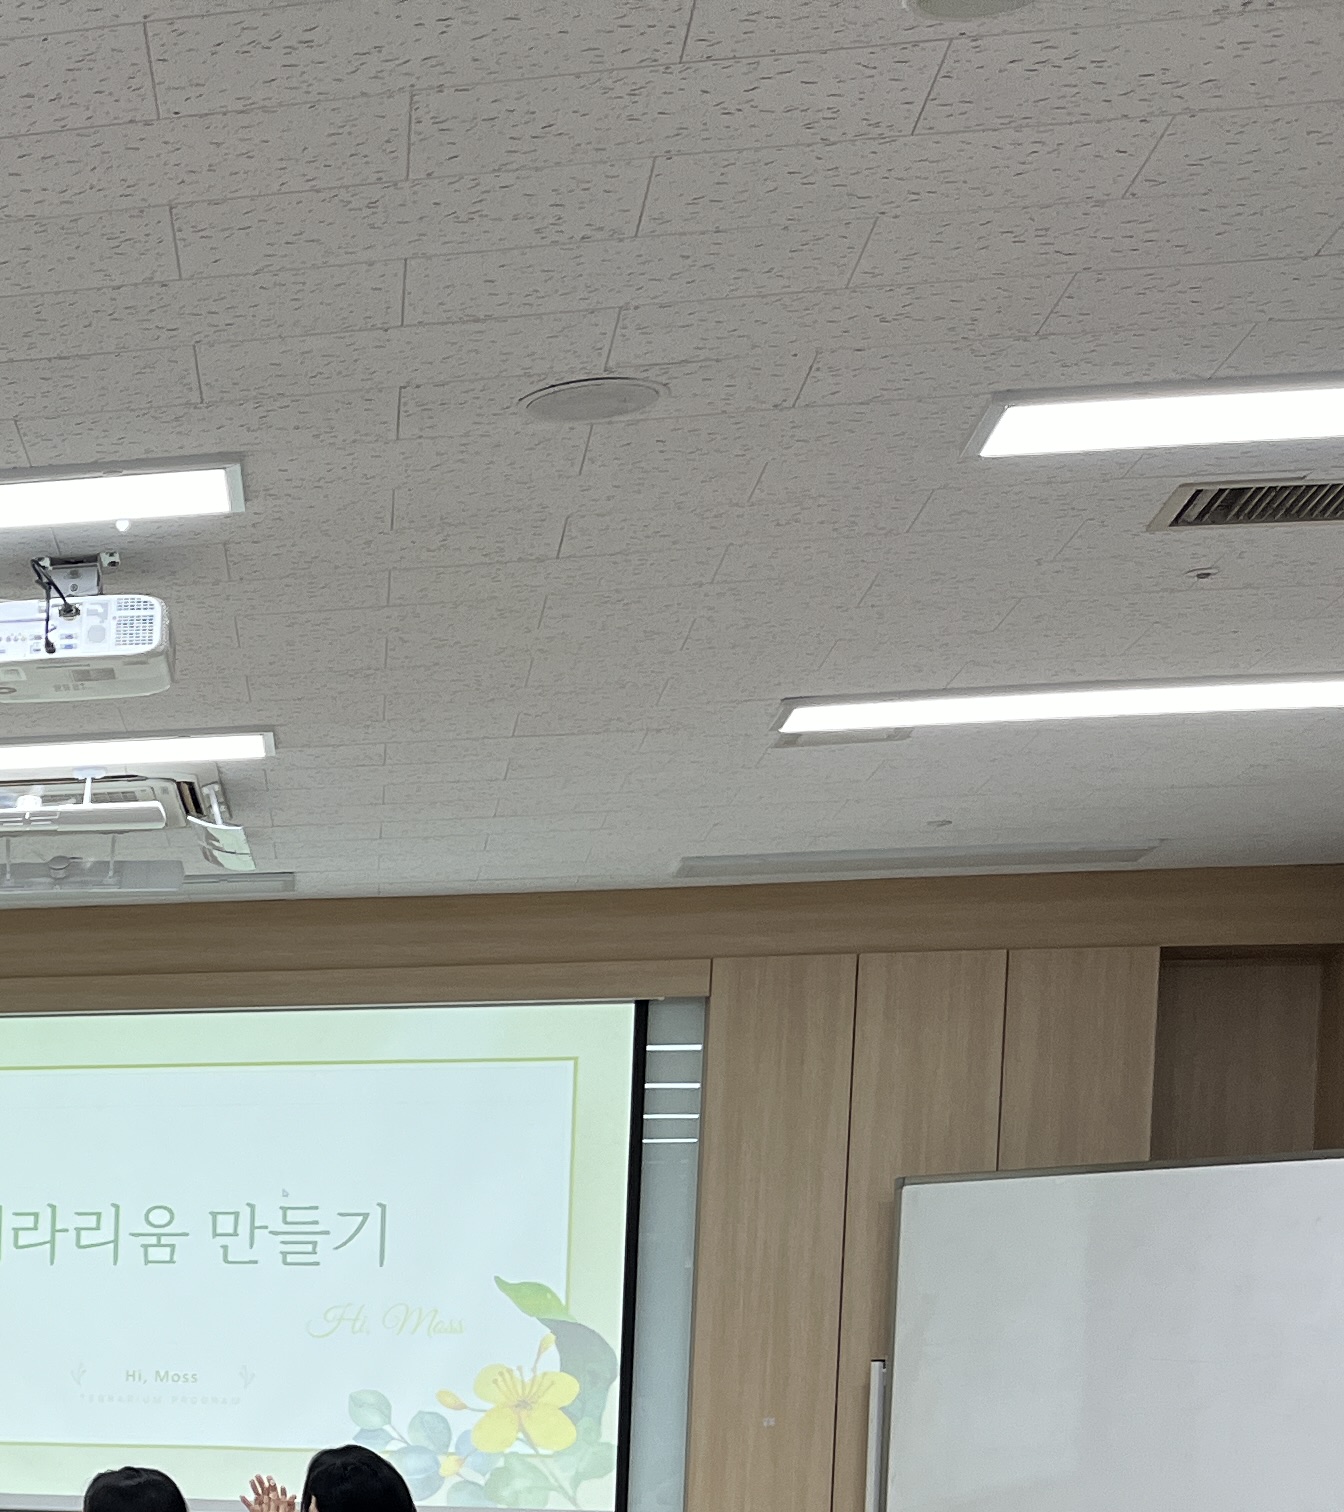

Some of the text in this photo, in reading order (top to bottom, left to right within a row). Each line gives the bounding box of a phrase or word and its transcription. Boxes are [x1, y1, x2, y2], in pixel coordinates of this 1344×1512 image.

[207, 1201, 390, 1269] 만들기
[125, 1369, 199, 1385] Hi, Moss
